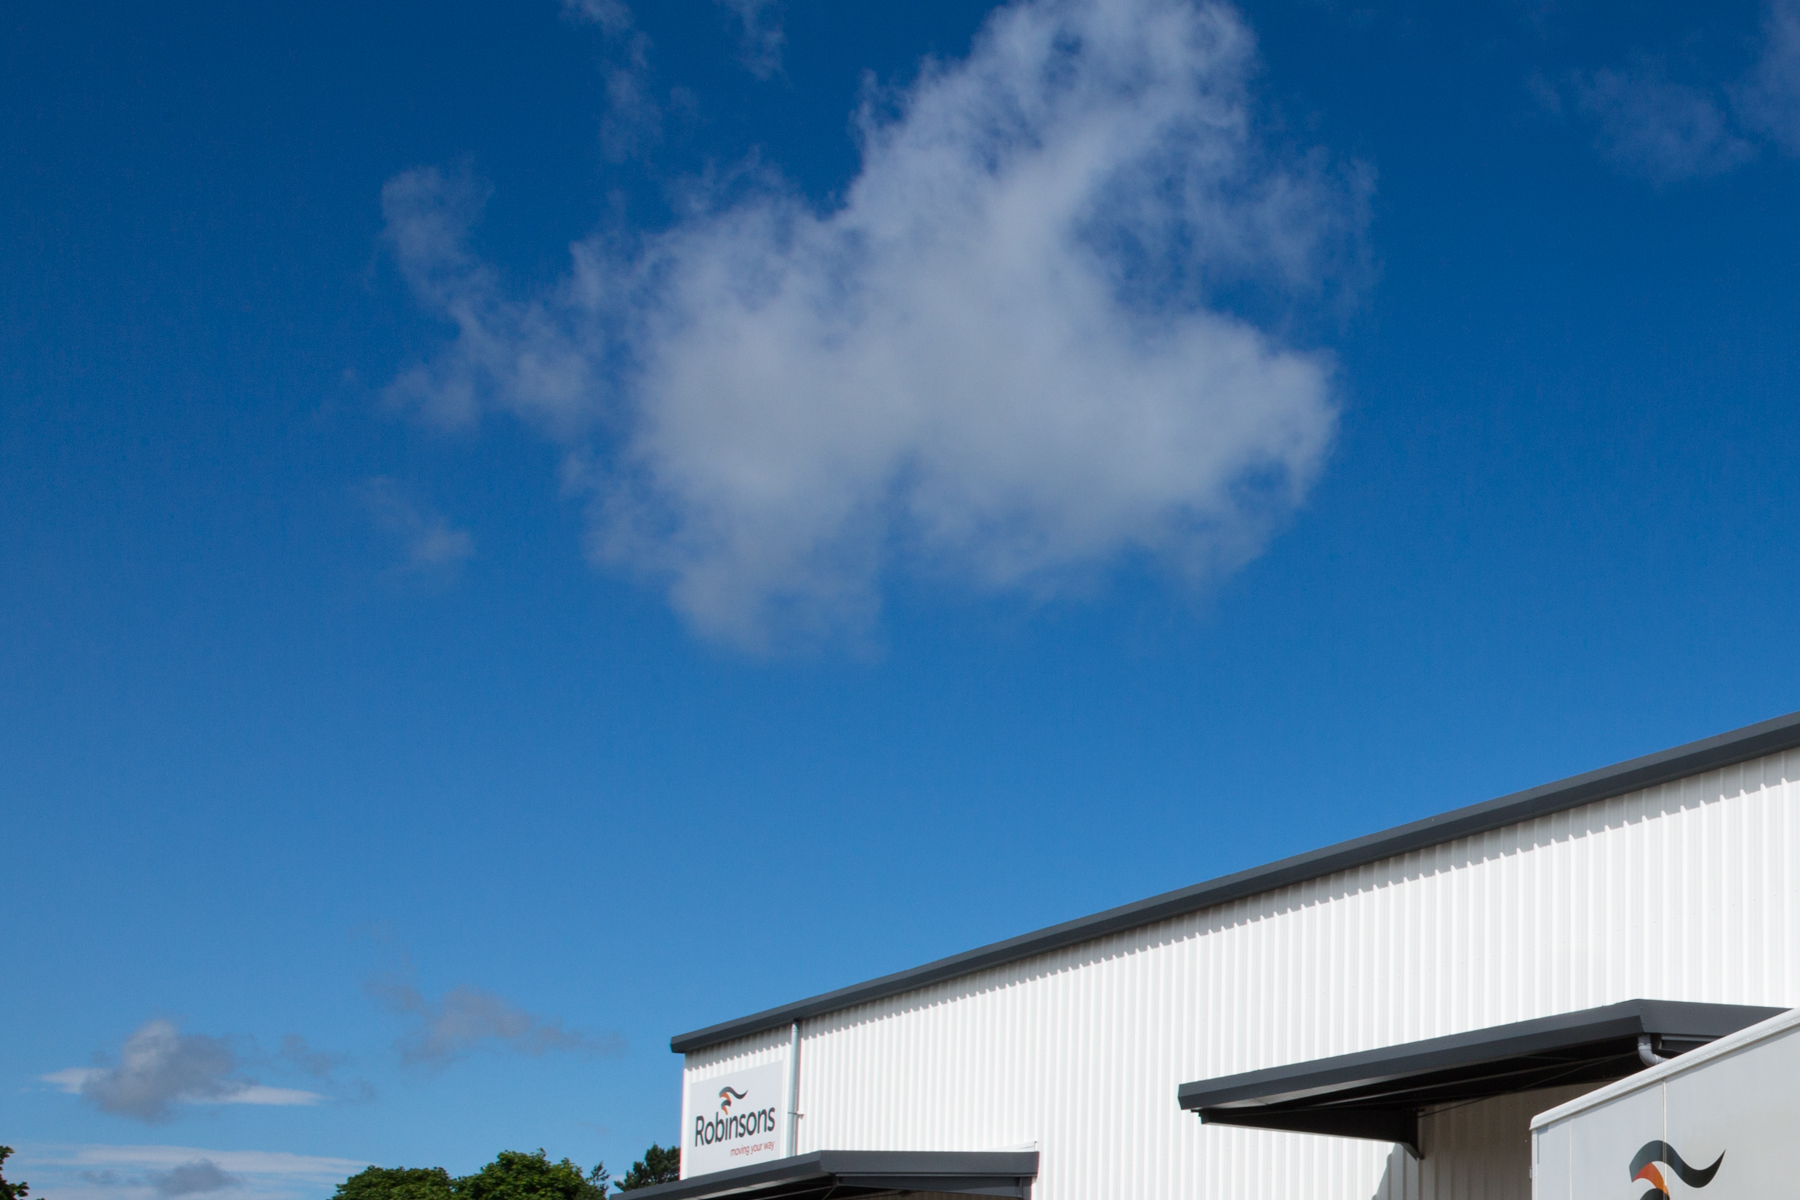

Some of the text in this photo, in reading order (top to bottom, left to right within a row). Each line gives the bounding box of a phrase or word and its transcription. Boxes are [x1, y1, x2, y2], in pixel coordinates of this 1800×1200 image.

[695, 1107, 776, 1147] Robinsons
[730, 1141, 776, 1156] moving your way
